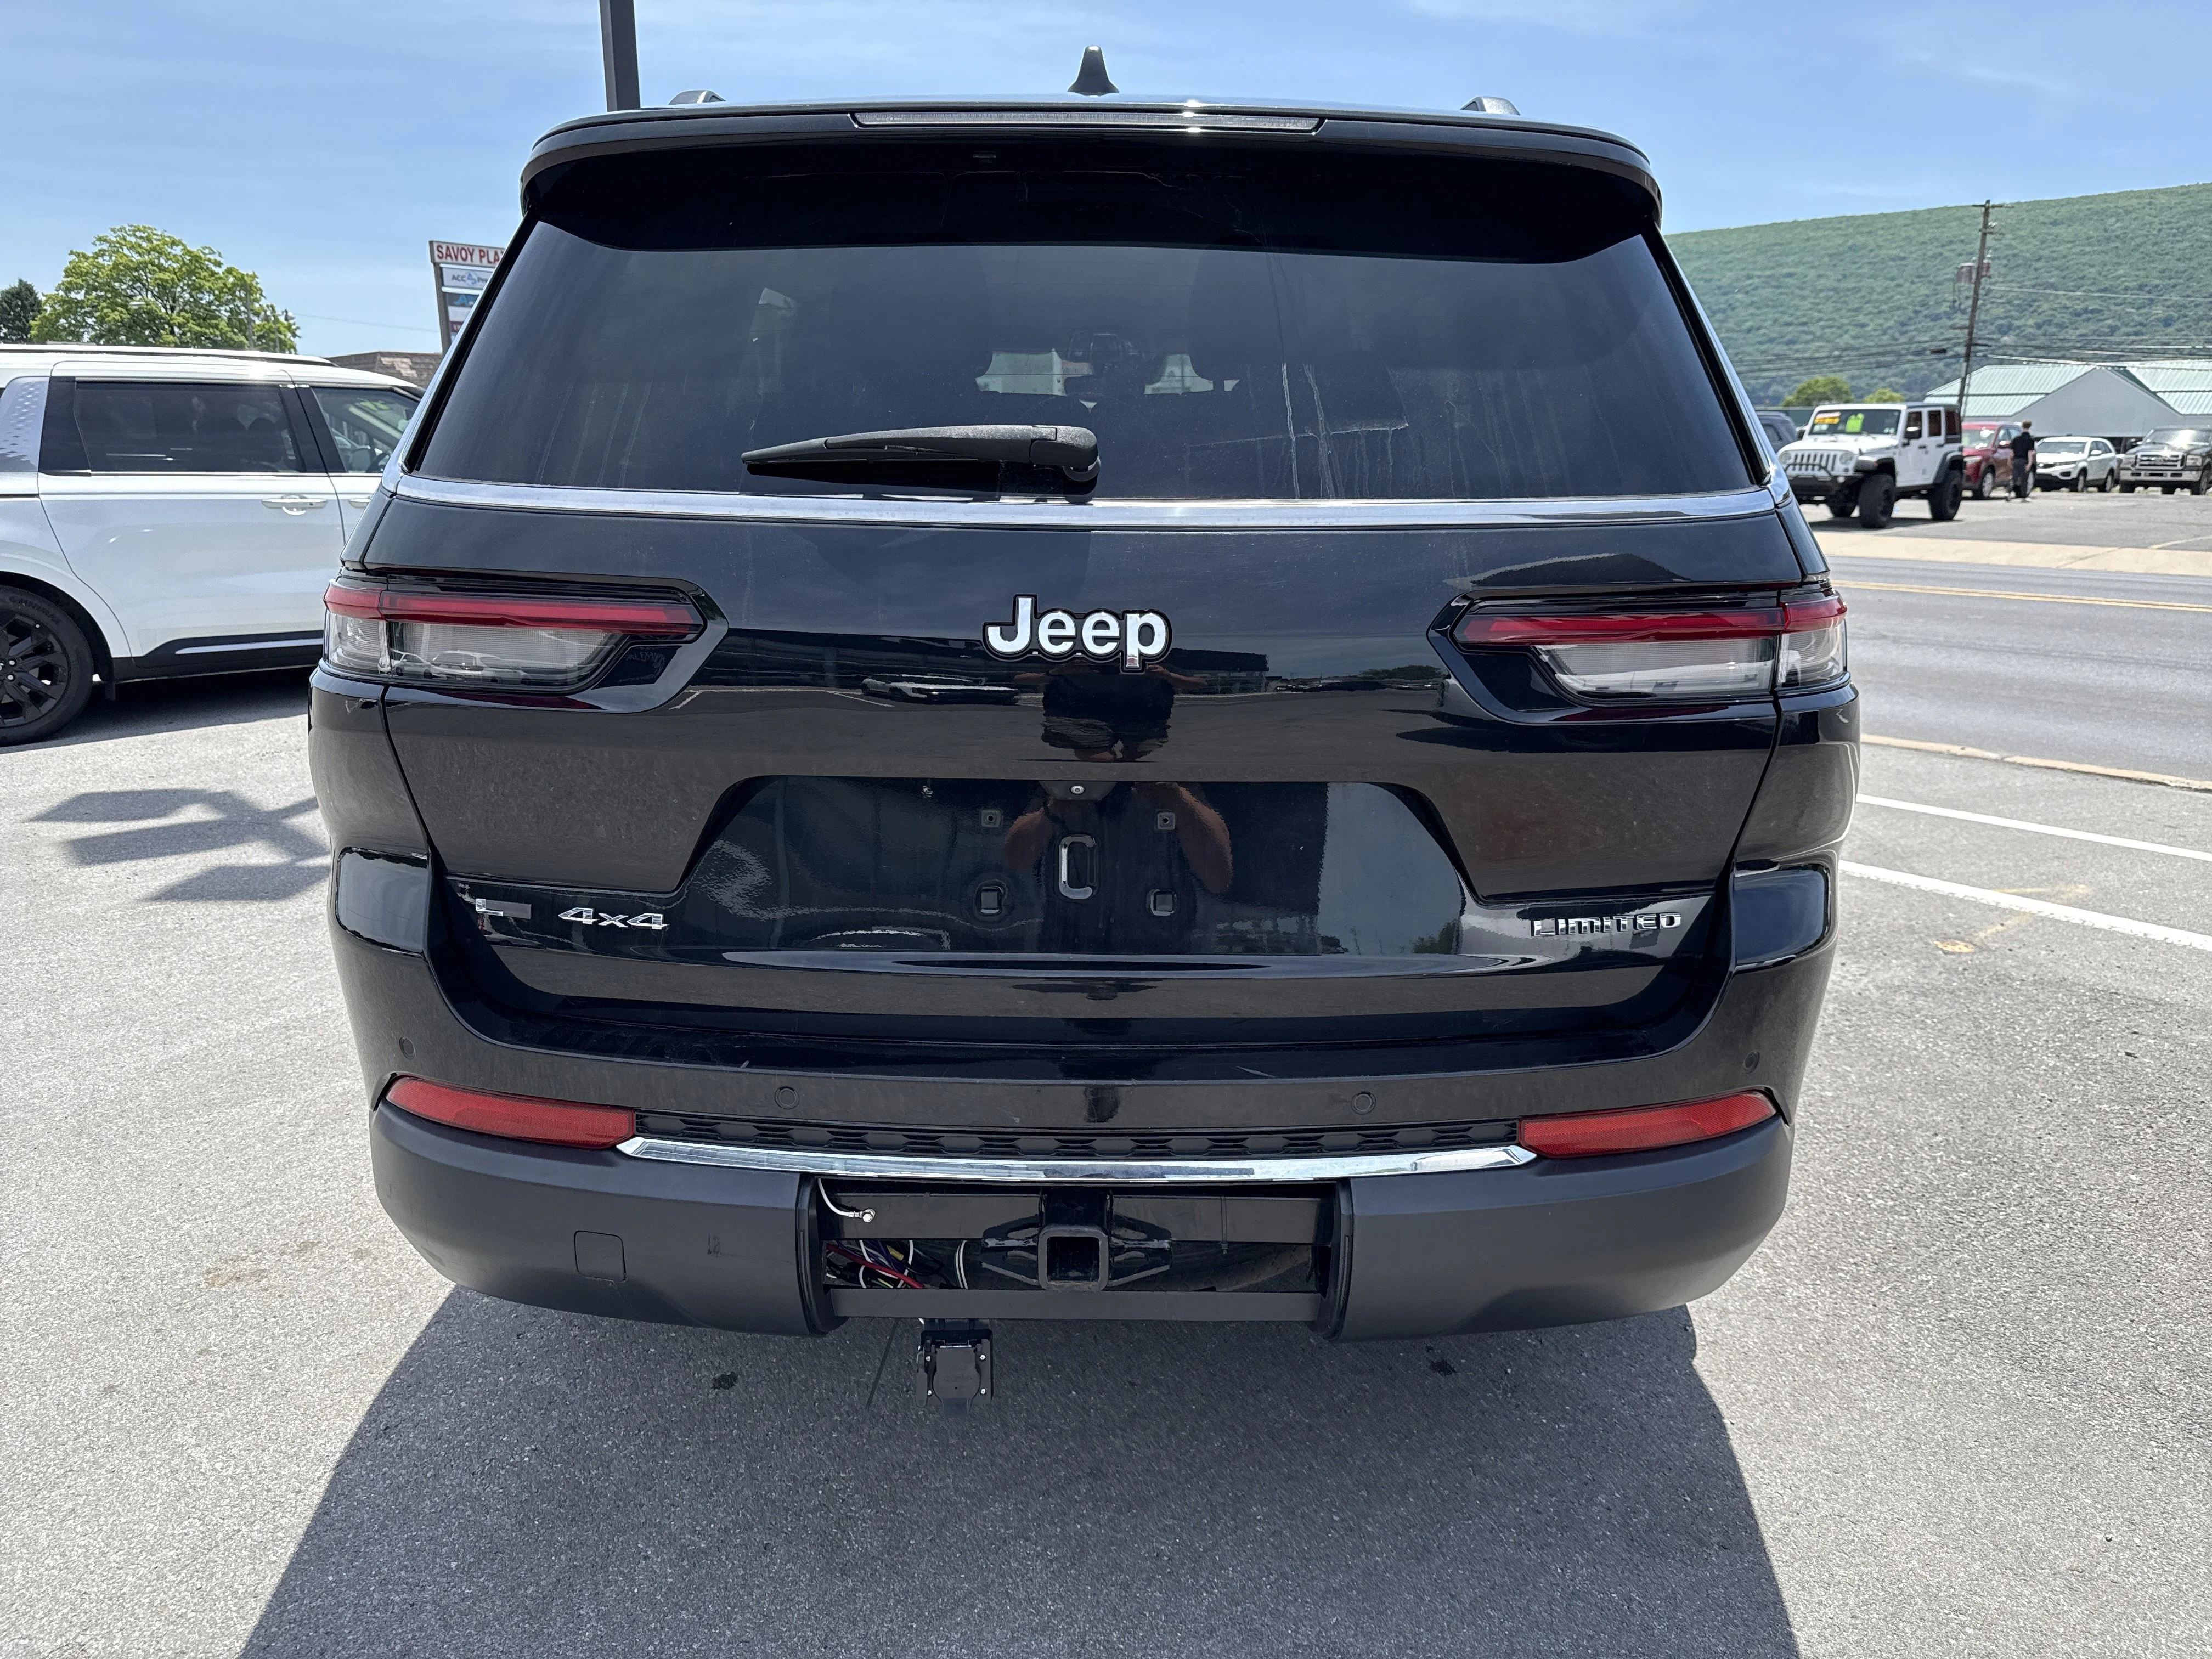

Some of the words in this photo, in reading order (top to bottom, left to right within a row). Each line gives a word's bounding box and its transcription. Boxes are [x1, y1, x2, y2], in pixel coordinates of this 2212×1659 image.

[437, 245, 475, 263] SAVOY
[479, 249, 505, 264] PLA
[987, 597, 1167, 668] Jeep
[558, 907, 670, 929] 4x4
[1532, 912, 1681, 936] LIMITED
